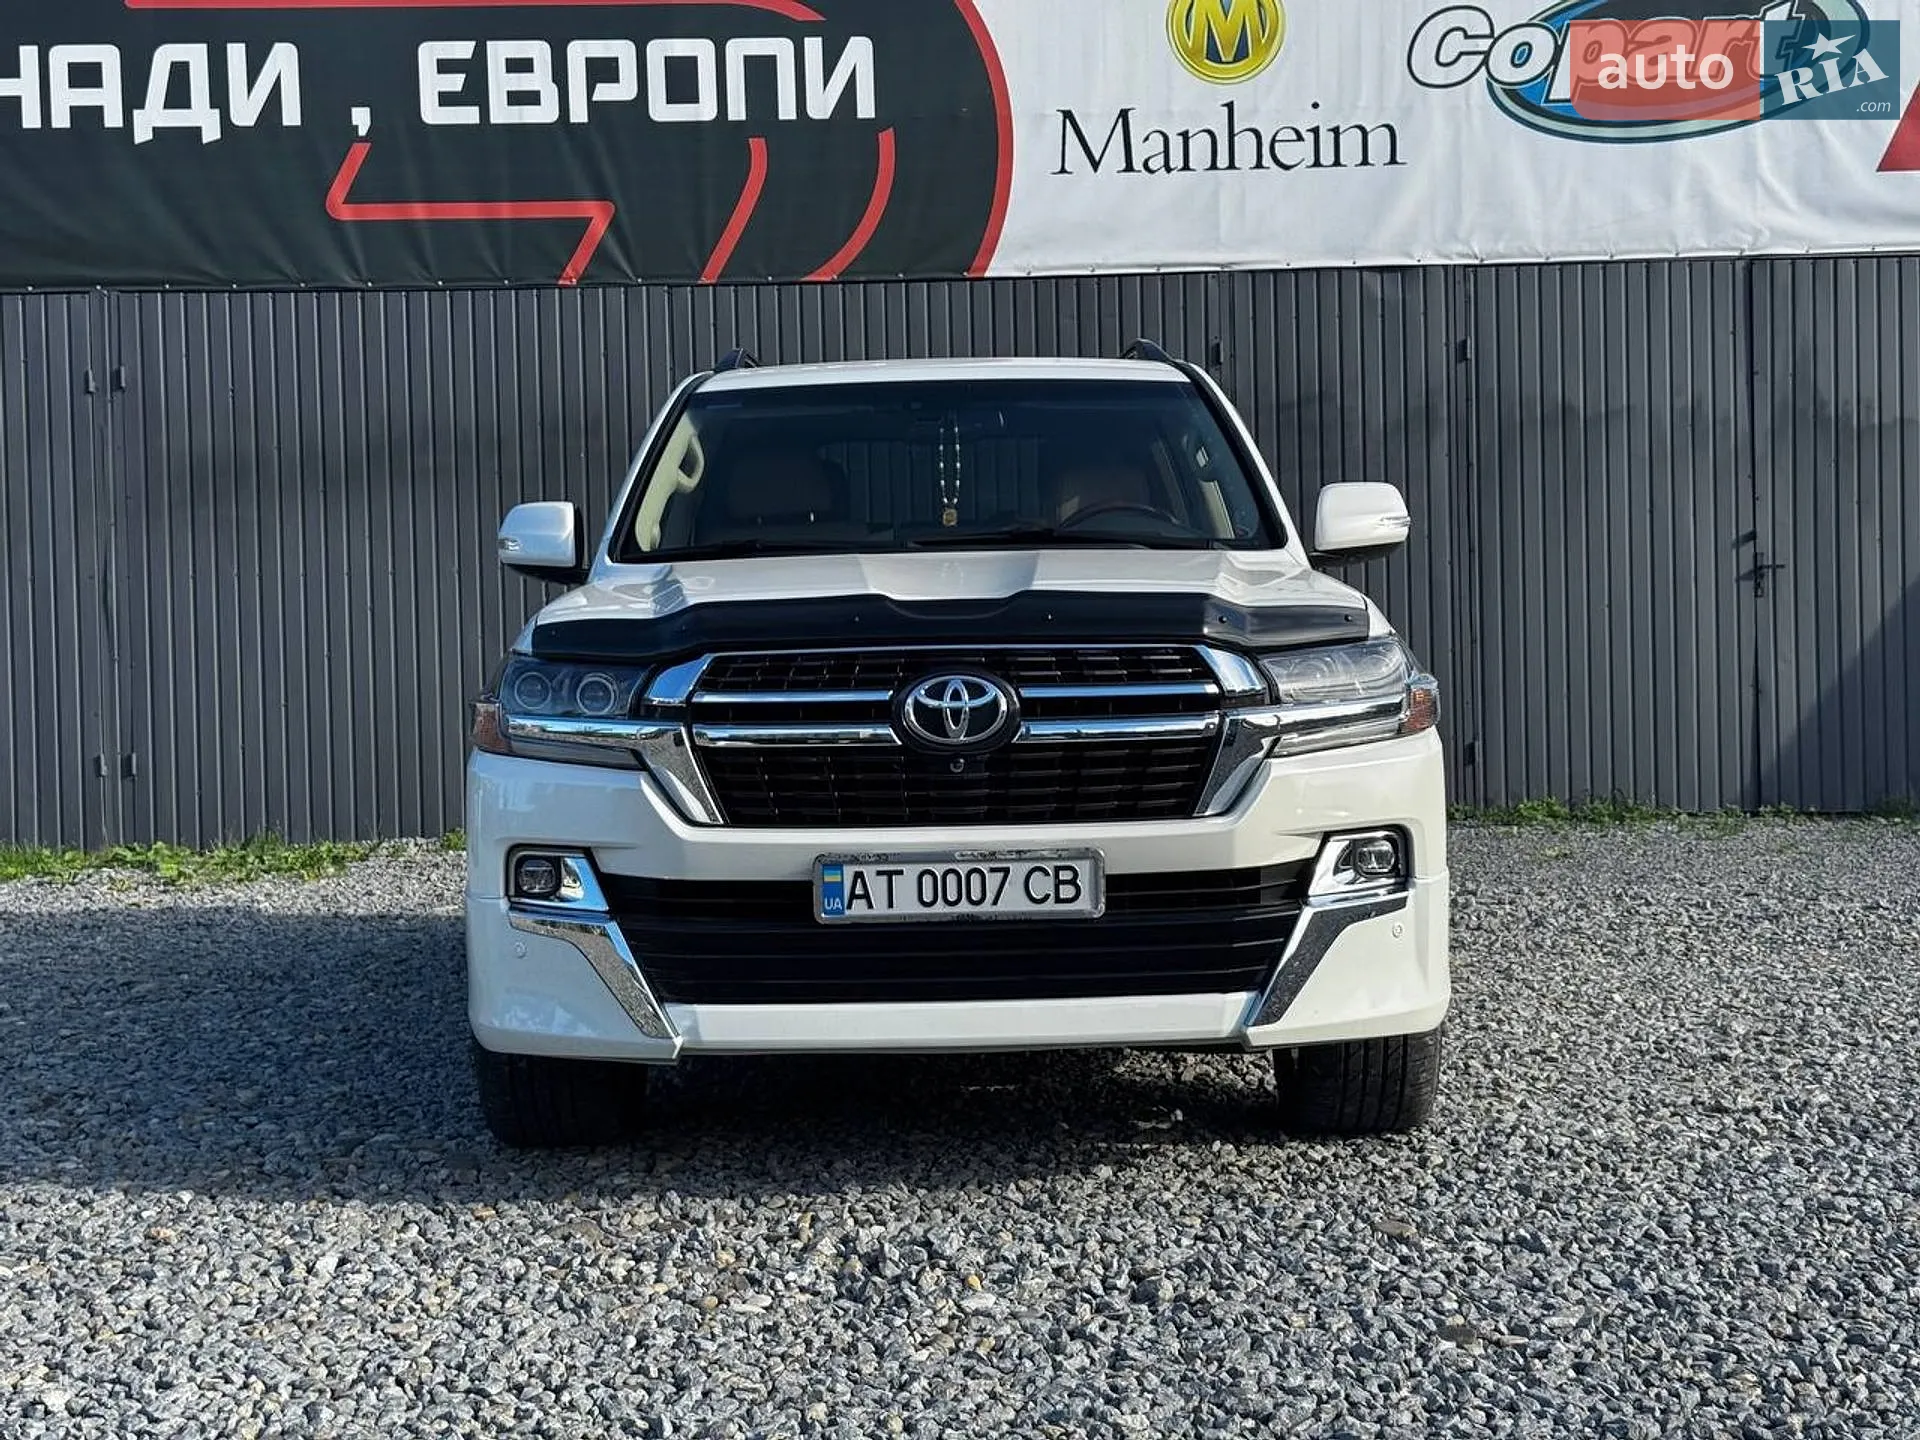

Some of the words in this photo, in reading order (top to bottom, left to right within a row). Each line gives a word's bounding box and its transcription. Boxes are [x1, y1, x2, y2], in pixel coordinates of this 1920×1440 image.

[417, 35, 877, 125] ЕВРОПИ
[1049, 101, 1407, 177] Manheim
[824, 897, 843, 911] UA
[846, 868, 905, 911] AT
[917, 866, 1011, 908] 0007
[1023, 864, 1082, 905] CB
